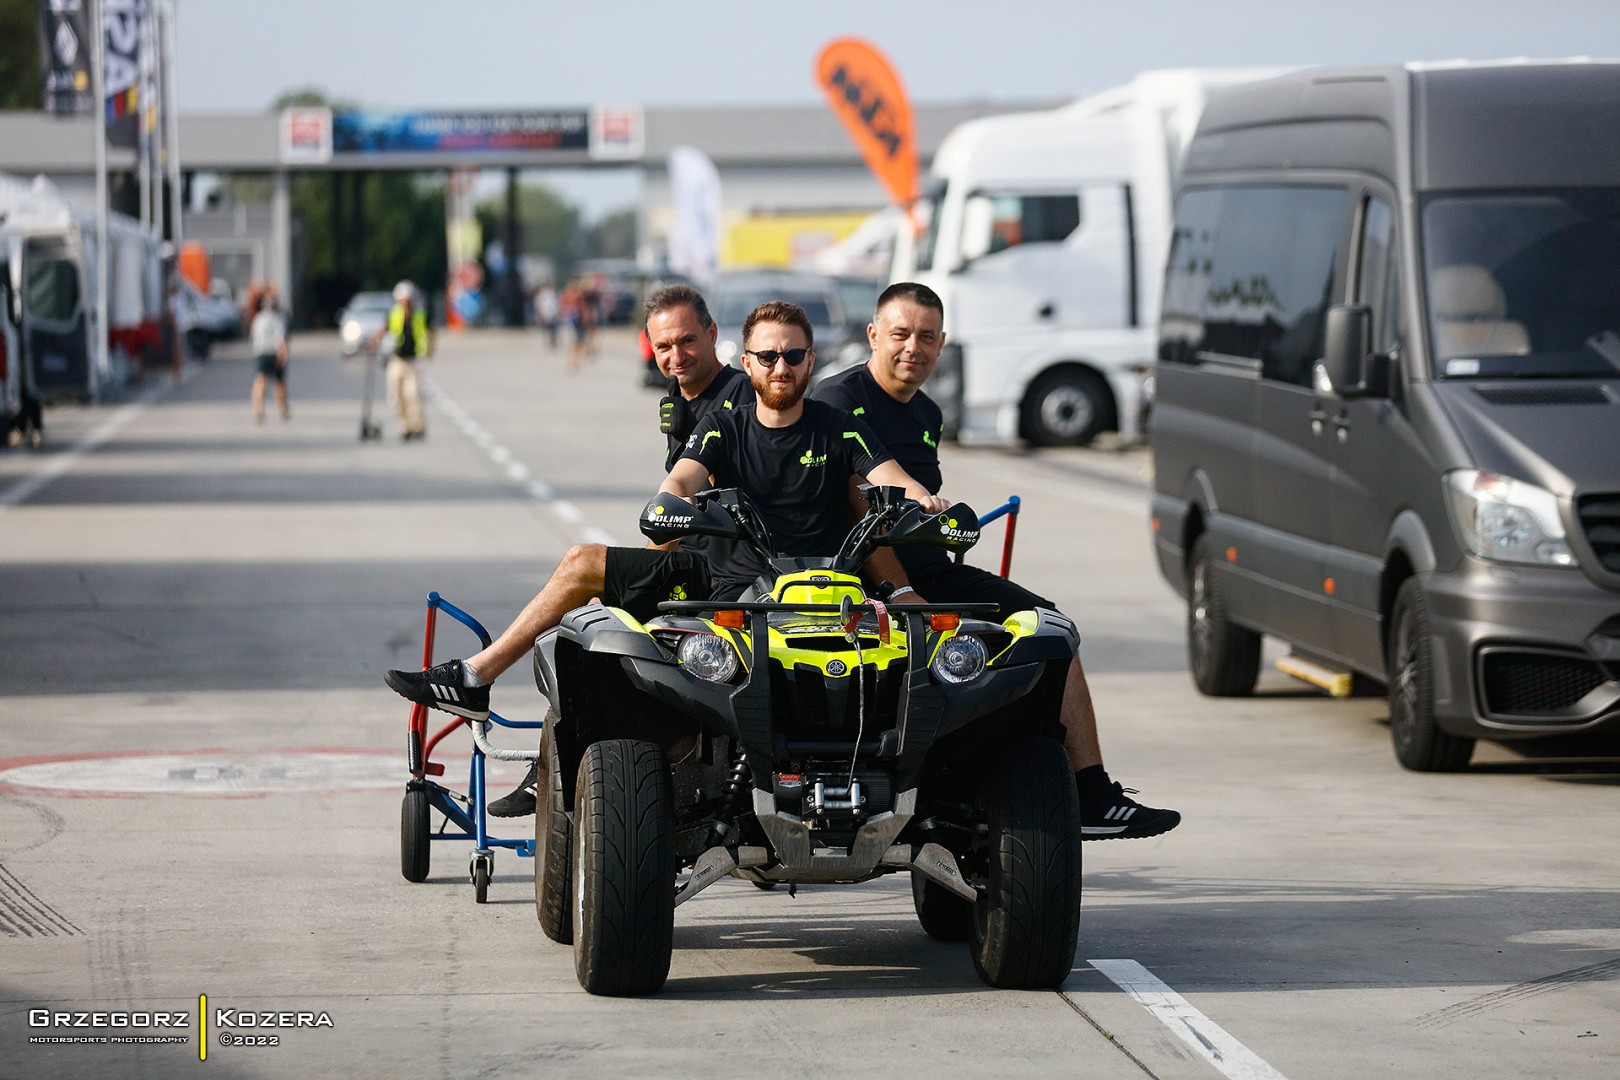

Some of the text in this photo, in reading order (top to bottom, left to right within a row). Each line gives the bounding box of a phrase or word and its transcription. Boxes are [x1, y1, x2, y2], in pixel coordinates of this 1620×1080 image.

[807, 454, 827, 463] OLIM
[655, 515, 694, 524] OLIMP
[949, 528, 980, 539] OLIMP
